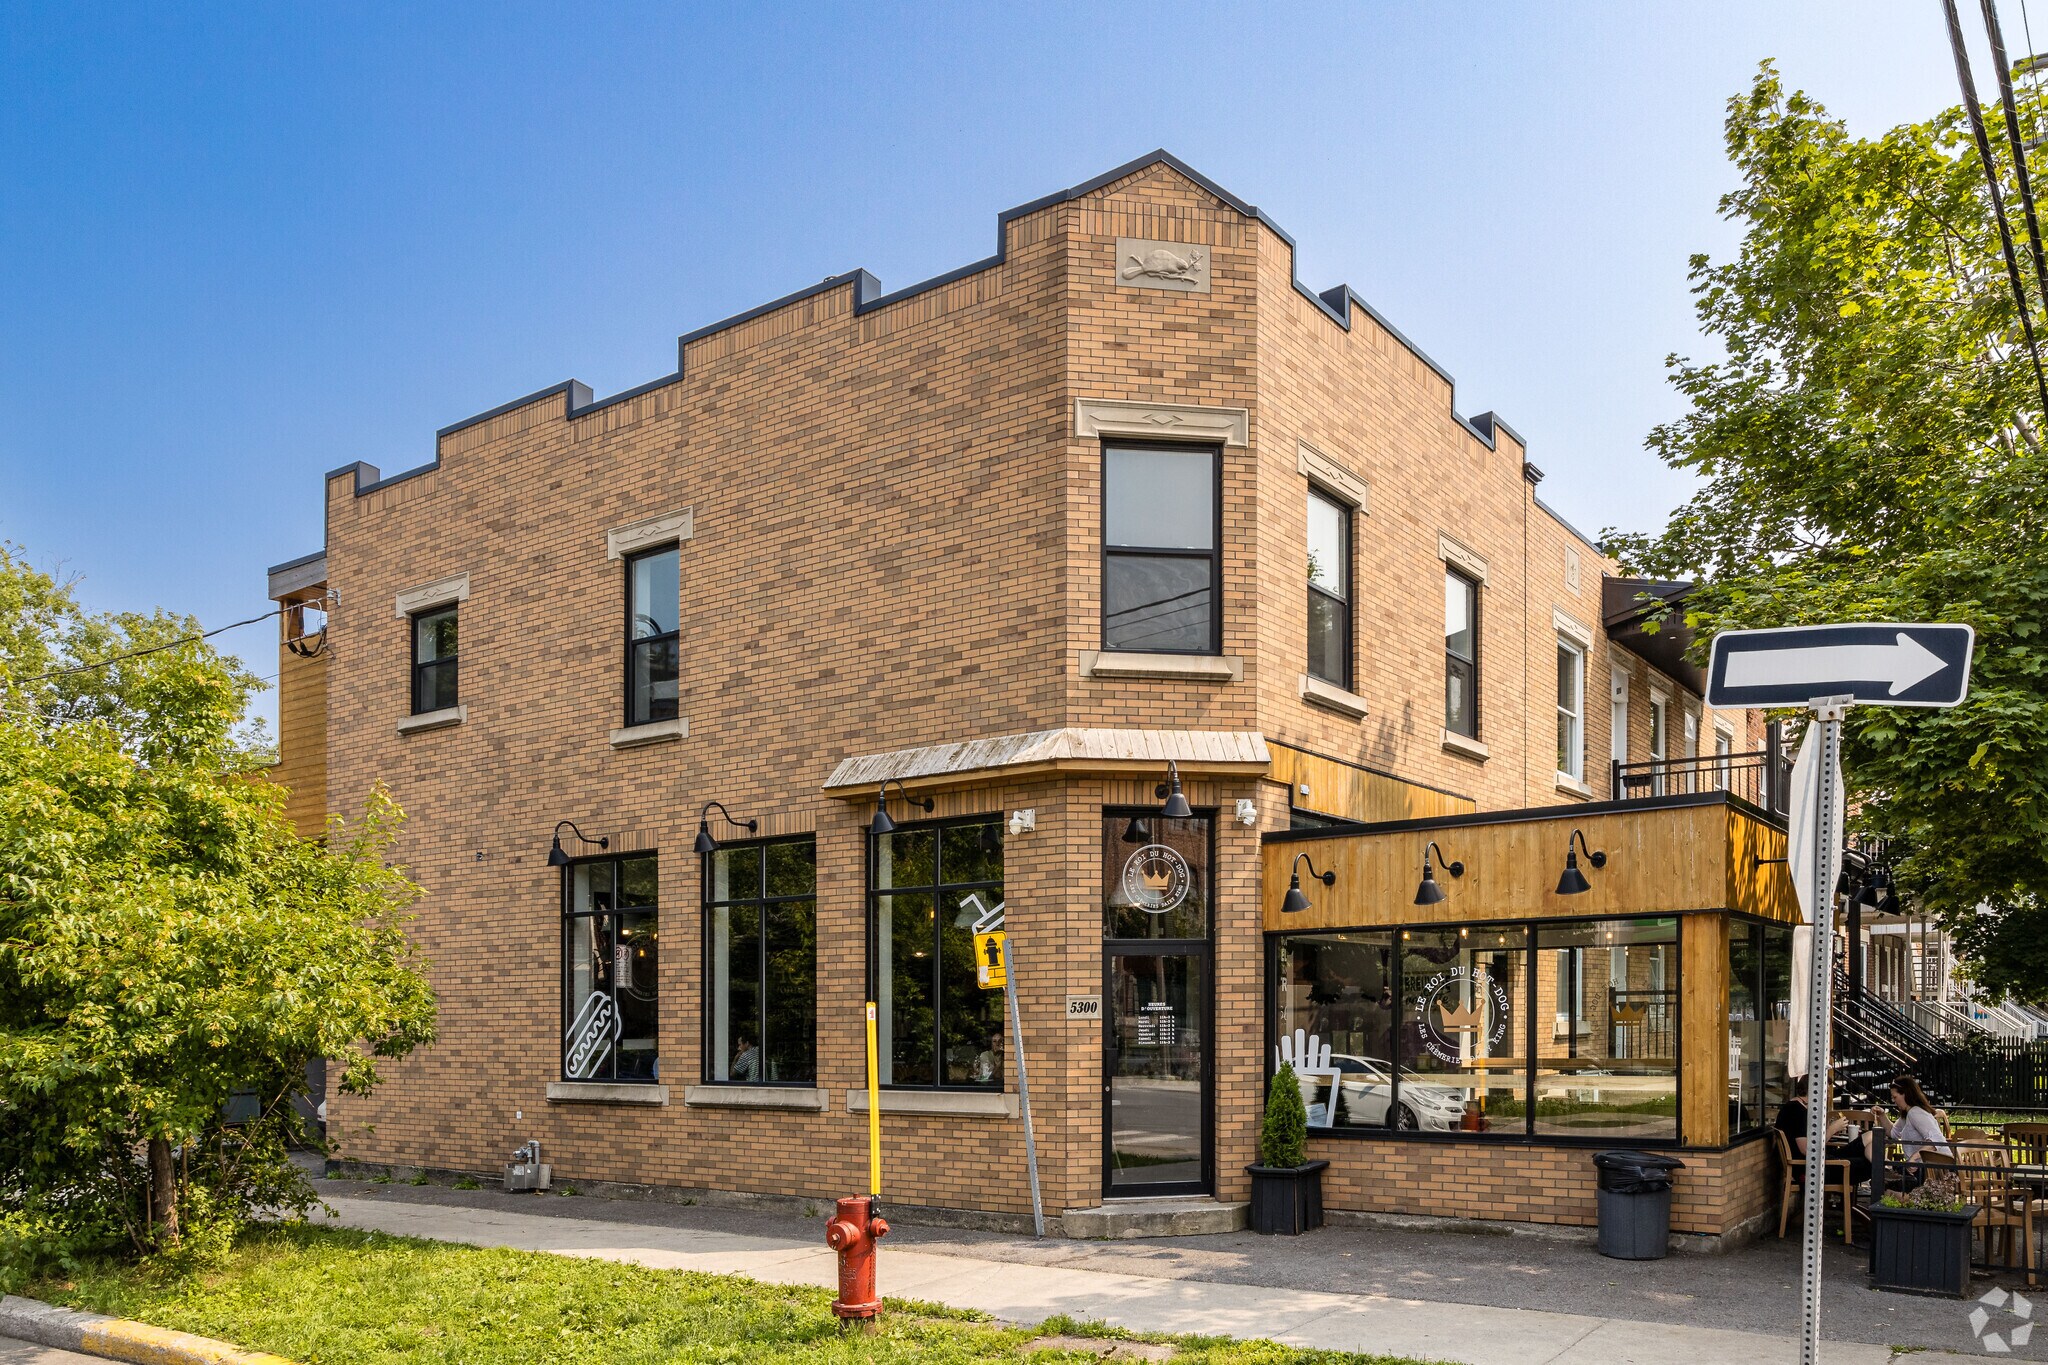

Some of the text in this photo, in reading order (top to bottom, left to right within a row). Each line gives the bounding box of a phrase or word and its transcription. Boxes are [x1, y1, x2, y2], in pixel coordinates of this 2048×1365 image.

[1128, 867, 1135, 877] LE
[1134, 854, 1146, 866] ROI
[1162, 852, 1185, 878] HOT-DOG
[1415, 996, 1427, 1012] LE
[1424, 972, 1445, 992] ROI
[1450, 966, 1465, 977] DU
[1471, 967, 1510, 1012] HOT-DOG
[1070, 1001, 1098, 1013] 5300
[1418, 1023, 1428, 1039] LES
[1426, 1041, 1464, 1064] CREMERIE
[1492, 1023, 1506, 1045] KING
